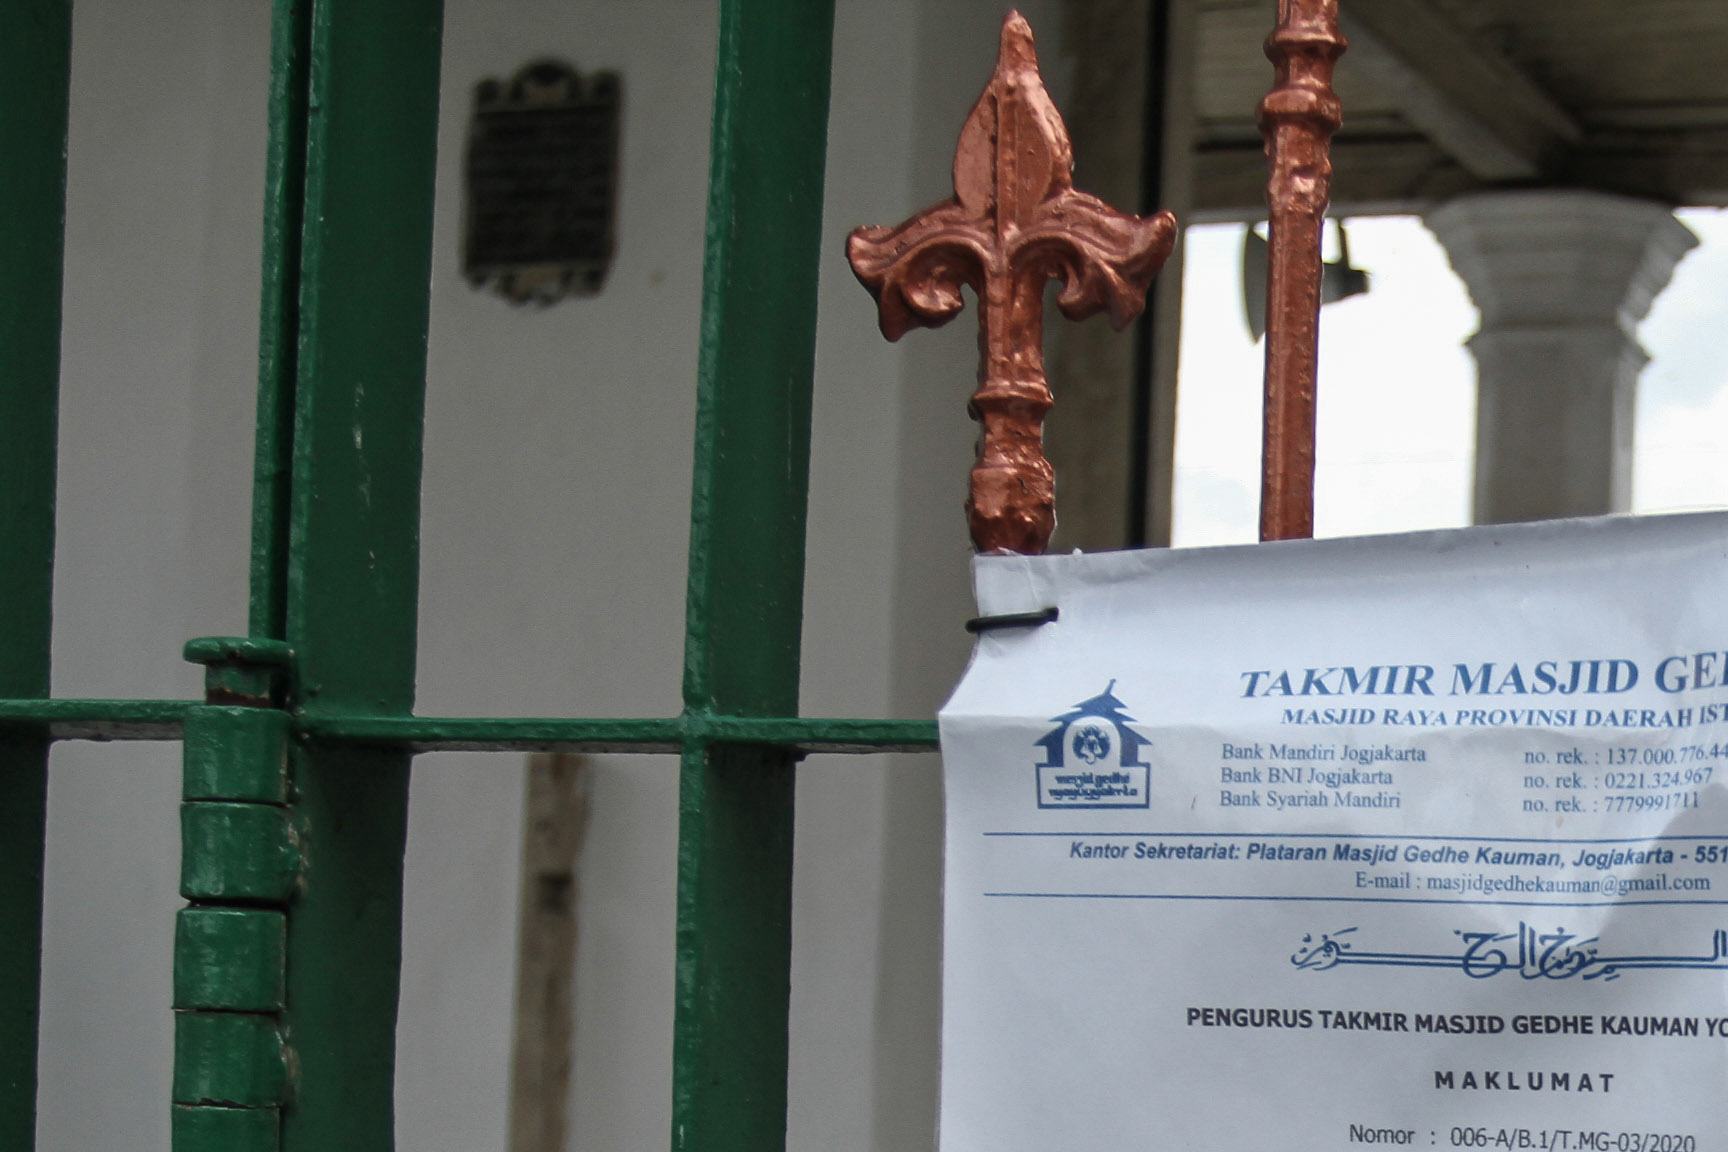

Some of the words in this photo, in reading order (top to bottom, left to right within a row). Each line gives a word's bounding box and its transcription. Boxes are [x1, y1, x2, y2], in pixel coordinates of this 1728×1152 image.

[1240, 664, 1435, 698] TAKMIR
[1448, 659, 1639, 696] MASJID
[1280, 708, 1376, 725] MASJID
[1382, 708, 1448, 726] RAYA
[1455, 709, 1578, 726] PROVINSI
[1584, 708, 1694, 728] DAERAH
[1222, 743, 1264, 760] Bank
[1270, 744, 1335, 760] Mandiri
[1340, 744, 1426, 766] Jogjakarta
[1221, 767, 1262, 784] Bank
[1268, 767, 1302, 784] BNI
[1307, 768, 1392, 789] Jogjakarta
[1604, 767, 1713, 790] 0221.324.967
[1220, 790, 1260, 806] Bank
[1267, 790, 1328, 811] Syariah
[1334, 792, 1400, 808] Mandiri
[1604, 792, 1698, 812] 7779991711
[1070, 842, 1130, 859] Kantor
[1134, 842, 1240, 860] Sekretariat:
[1246, 842, 1327, 860] Plataran
[1332, 844, 1398, 866] Masjid
[1404, 844, 1470, 864] Gedhe
[1474, 846, 1565, 870] Kauman,
[1572, 847, 1674, 870] Jogjakarta
[1356, 872, 1410, 888] E-mail
[1427, 873, 1710, 896] masjidgedhekauman@gmail.com
[1187, 1008, 1314, 1028] PENGURUS
[1318, 1010, 1410, 1032] TAKMIR
[1414, 1014, 1505, 1034] MASJID
[1512, 1015, 1594, 1034] GEDHE
[1601, 1016, 1699, 1037] KAUMAN
[1350, 1124, 1416, 1144] Nomor
